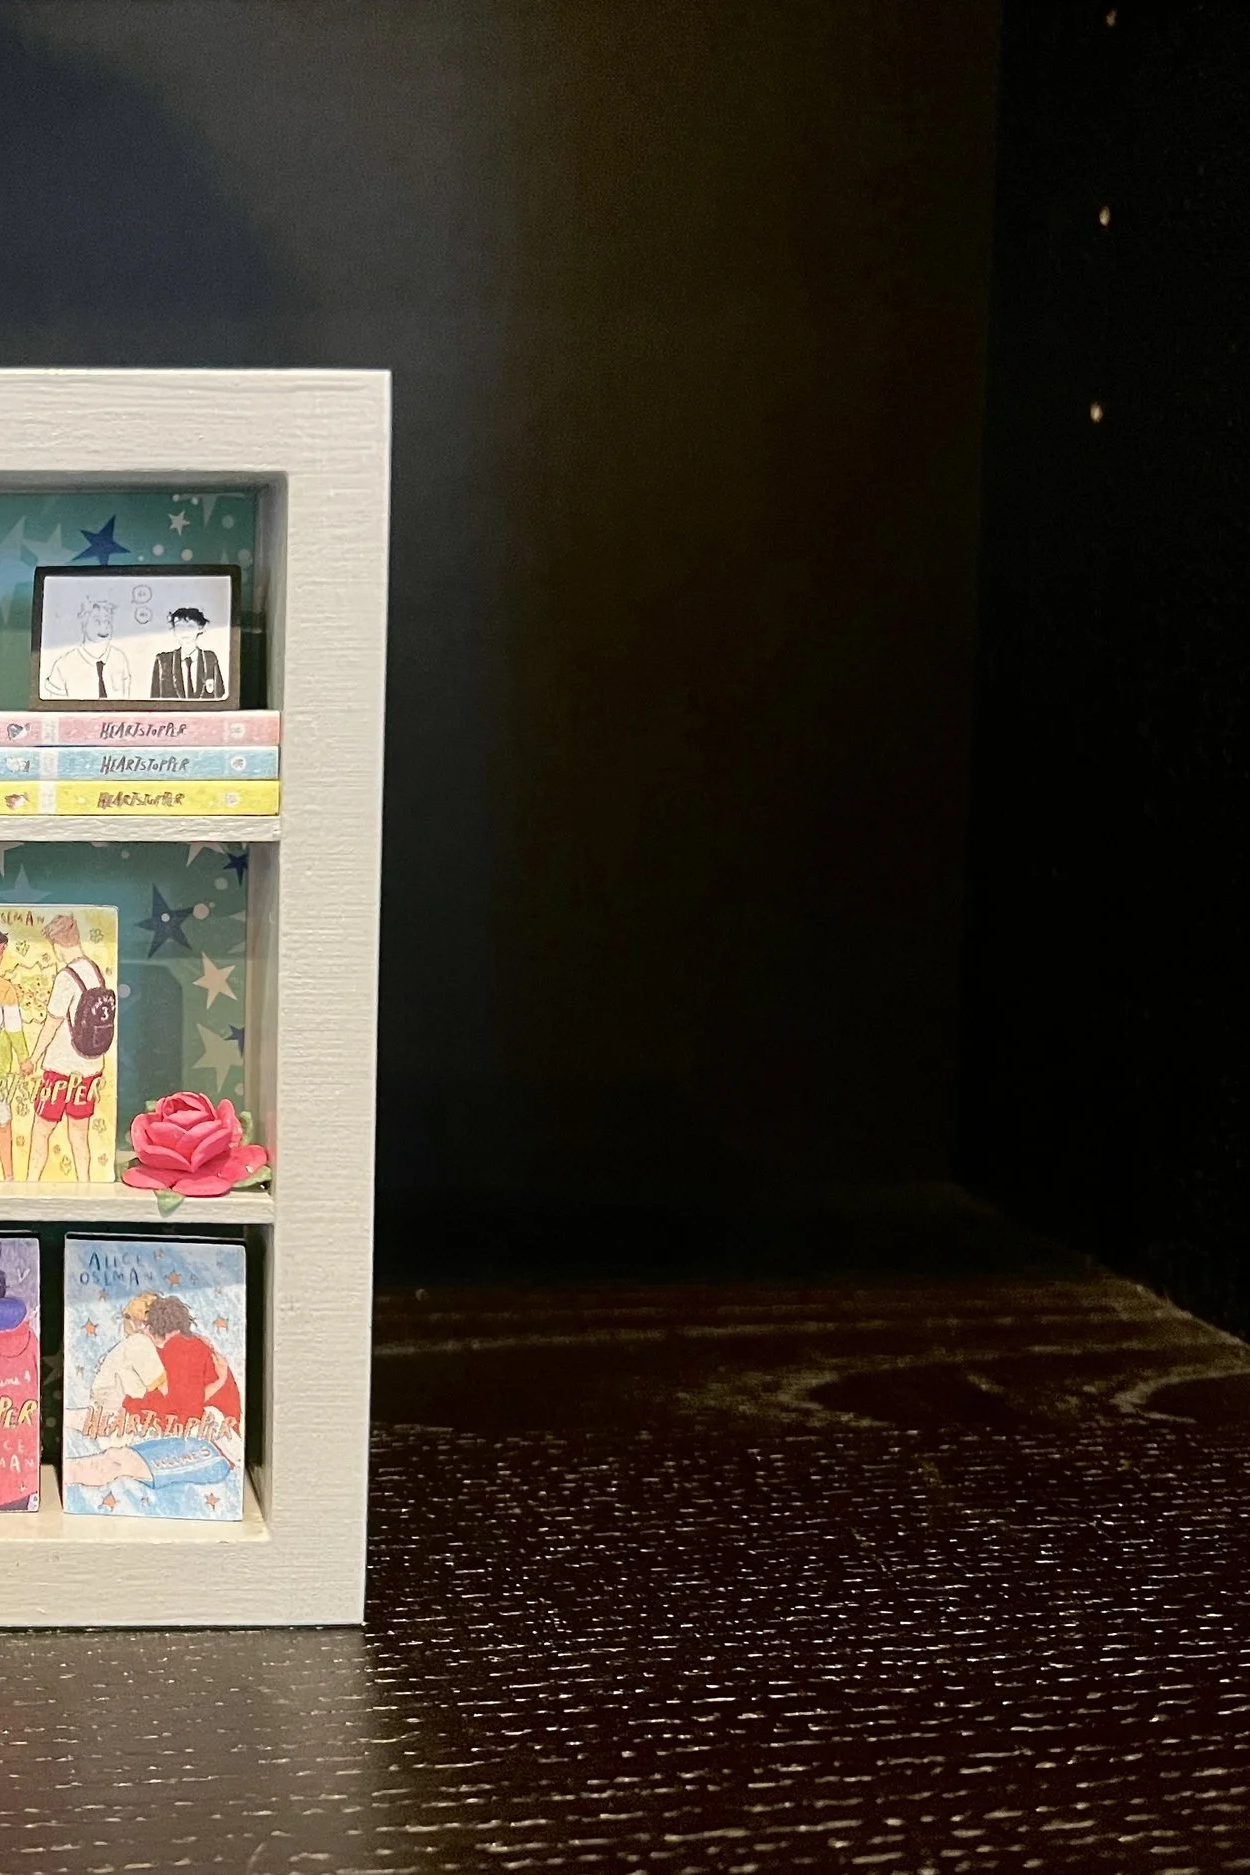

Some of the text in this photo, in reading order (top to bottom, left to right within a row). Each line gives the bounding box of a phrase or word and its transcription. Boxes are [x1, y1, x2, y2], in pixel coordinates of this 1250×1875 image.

[100, 722, 187, 739] HEARTSTOPPER
[101, 755, 189, 773] HEARTSTOPPER
[97, 792, 185, 808] HEARTSTOPPER
[88, 1251, 143, 1270] ALICE
[81, 1404, 238, 1441] HEARTSTOPPER
